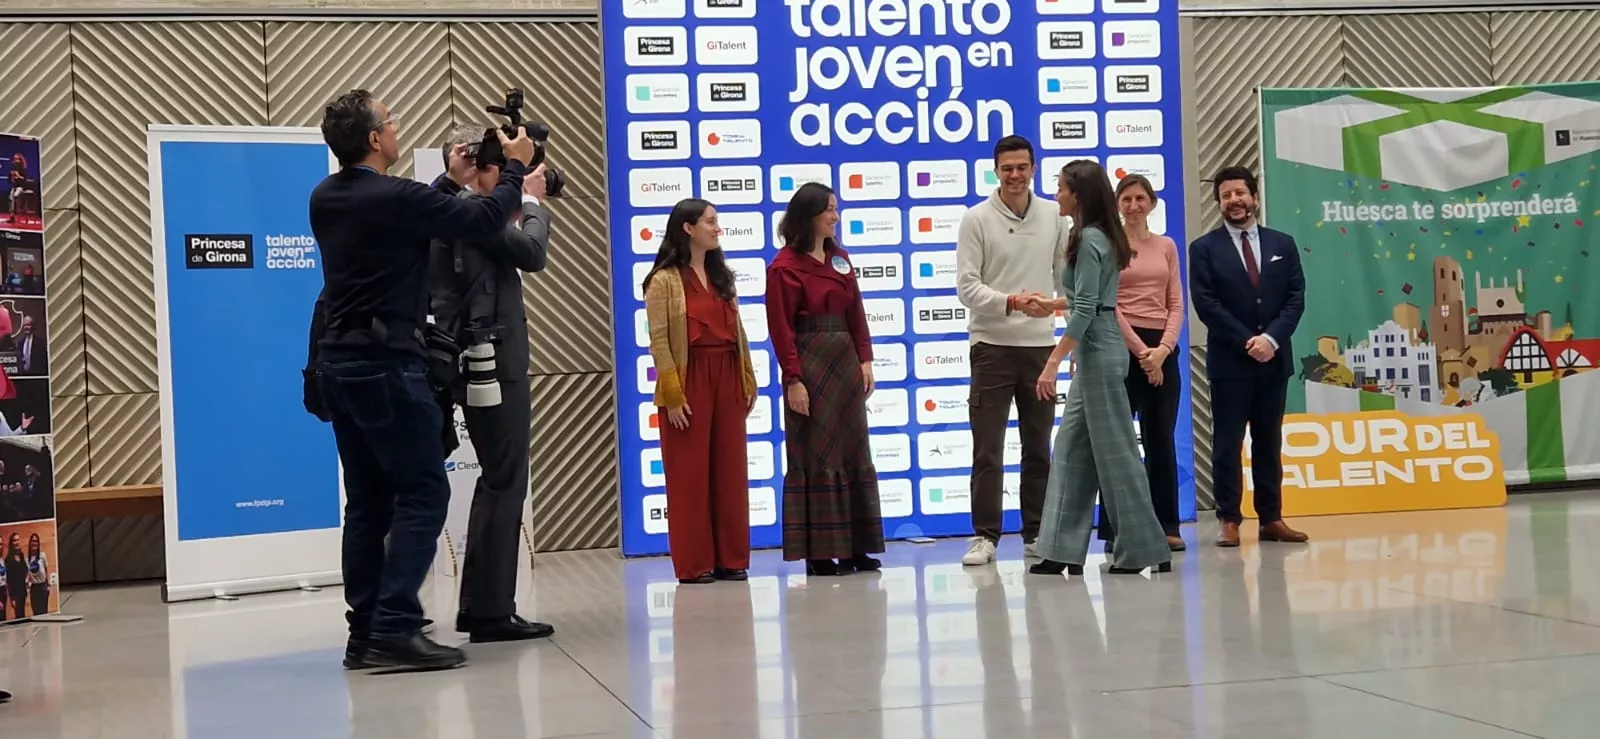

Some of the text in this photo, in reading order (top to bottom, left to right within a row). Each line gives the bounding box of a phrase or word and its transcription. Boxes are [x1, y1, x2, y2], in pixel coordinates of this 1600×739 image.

[784, 0, 1011, 37] talento
[707, 41, 746, 50] GiTalent
[789, 41, 1013, 102] joven en
[790, 86, 1014, 146] acción
[1116, 124, 1152, 133] GiTalent
[641, 183, 681, 192] GiTalent
[1321, 193, 1578, 223] Huesca te sorprenderá
[191, 238, 246, 249] Princesa
[265, 233, 315, 246] talento
[191, 251, 247, 263] de Girona
[267, 247, 304, 260] joven
[266, 257, 315, 269] acción
[925, 355, 963, 364] GiTalent
[1414, 421, 1490, 451] DEL
